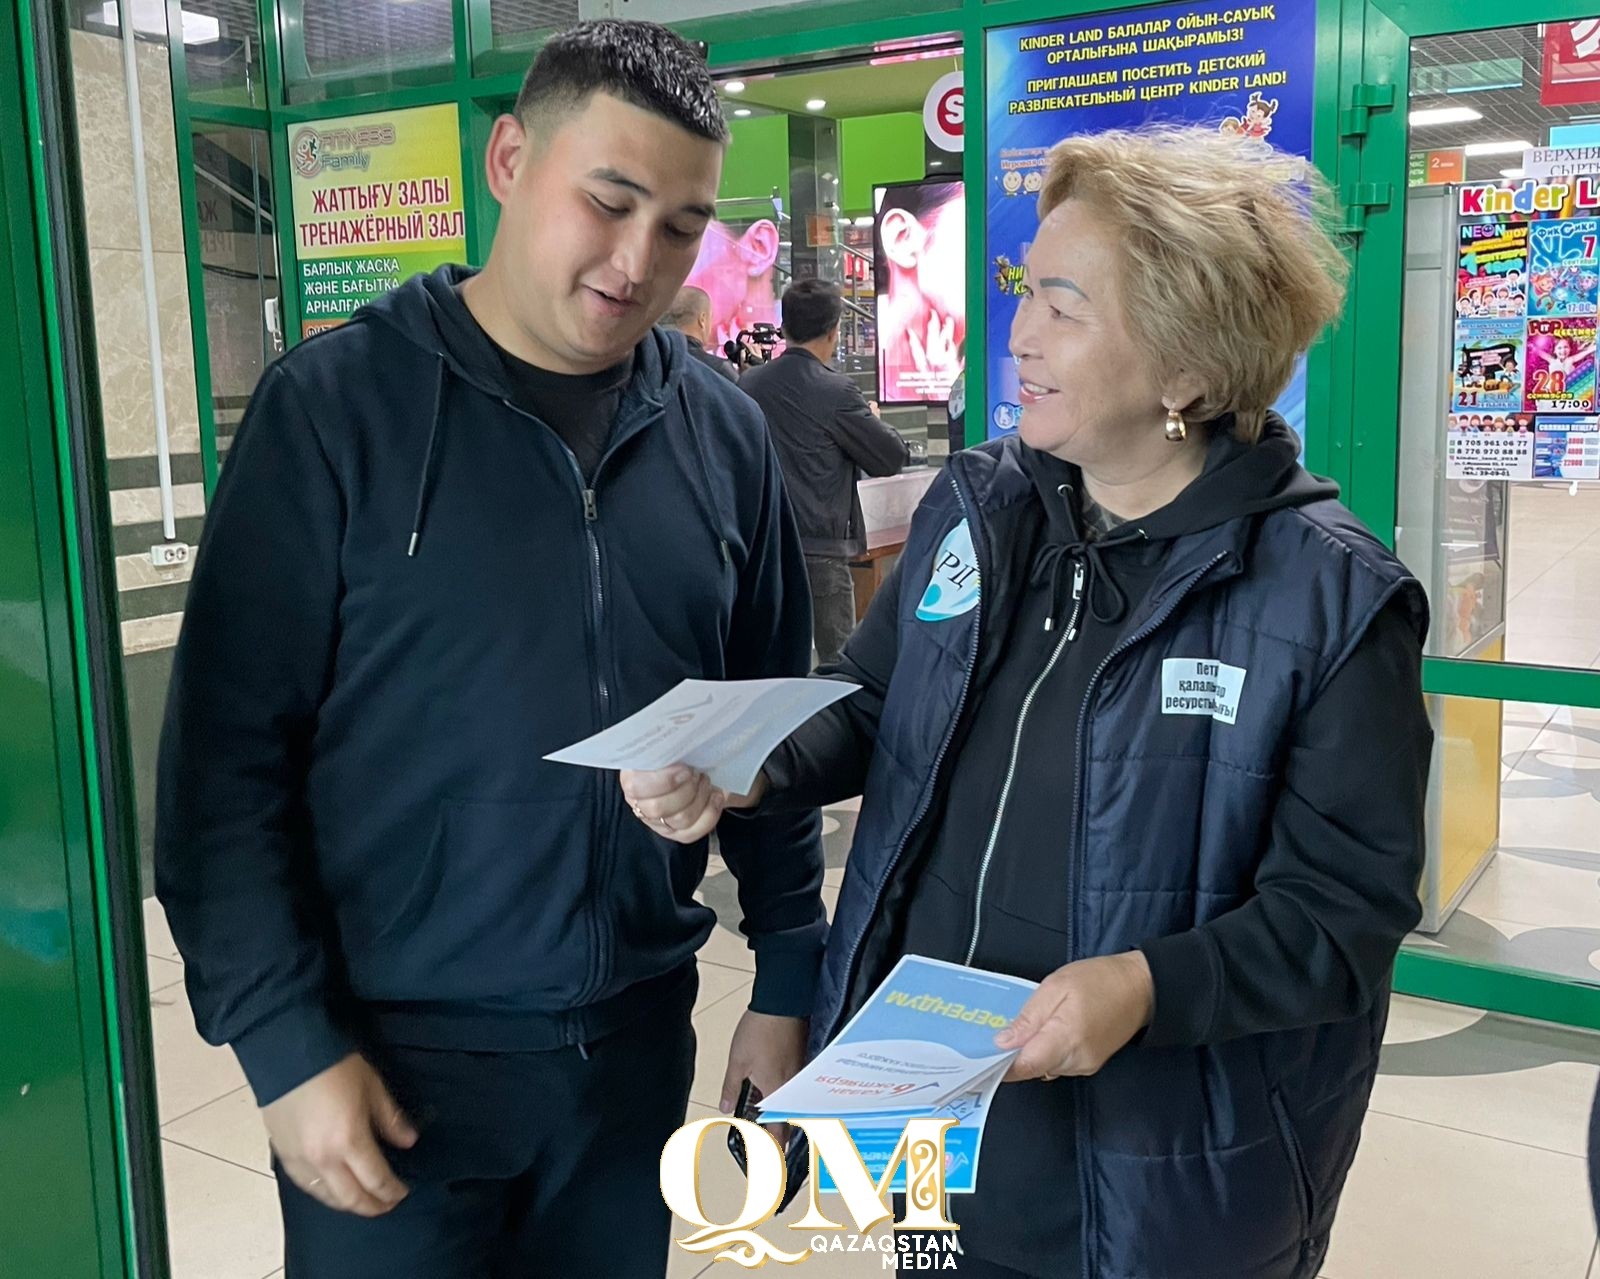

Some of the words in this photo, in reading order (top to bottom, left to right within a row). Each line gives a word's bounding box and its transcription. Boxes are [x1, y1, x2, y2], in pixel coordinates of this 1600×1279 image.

[1020, 34, 1065, 51] KINDER
[1069, 29, 1103, 44] LAND
[1108, 20, 1171, 39] БАЛАЛАР
[1177, 5, 1275, 30] ОЙЫН-САУЫҚ
[1047, 42, 1138, 64] ОРТАЛЫҒЫНА
[1143, 28, 1244, 52] ШАҚЫРАМЫЗ!
[1027, 71, 1117, 93] ПРИГЛАШАЕМ
[1122, 62, 1192, 82] ПОСЕТИТЬ
[1197, 50, 1265, 75] ДЕТСКИЙ
[1009, 86, 1136, 114] РАЗВЛЕКАТЕЛЬНЫЙ
[1140, 83, 1184, 101] ЦЕНТР
[1189, 77, 1239, 94] KINDER
[1244, 71, 1287, 88] LAND!
[320, 150, 371, 171] Family
[312, 183, 393, 214] ЖАТТЫҒУ
[398, 178, 449, 206] ЗАЛЫ
[1461, 181, 1567, 215] Kinder
[1578, 179, 1600, 206] L
[300, 211, 424, 247] ТРЕНАЖЁРНЫЙ
[428, 211, 464, 238] ЗАЛ
[1583, 236, 1597, 258] 7
[303, 261, 353, 277] БАРЛЫҚ
[356, 258, 400, 274] ЖАСҚА
[304, 281, 339, 296] ЖӘНЕ
[1532, 369, 1567, 394] 28
[1458, 391, 1477, 406] 21
[1551, 400, 1591, 409] 17:00
